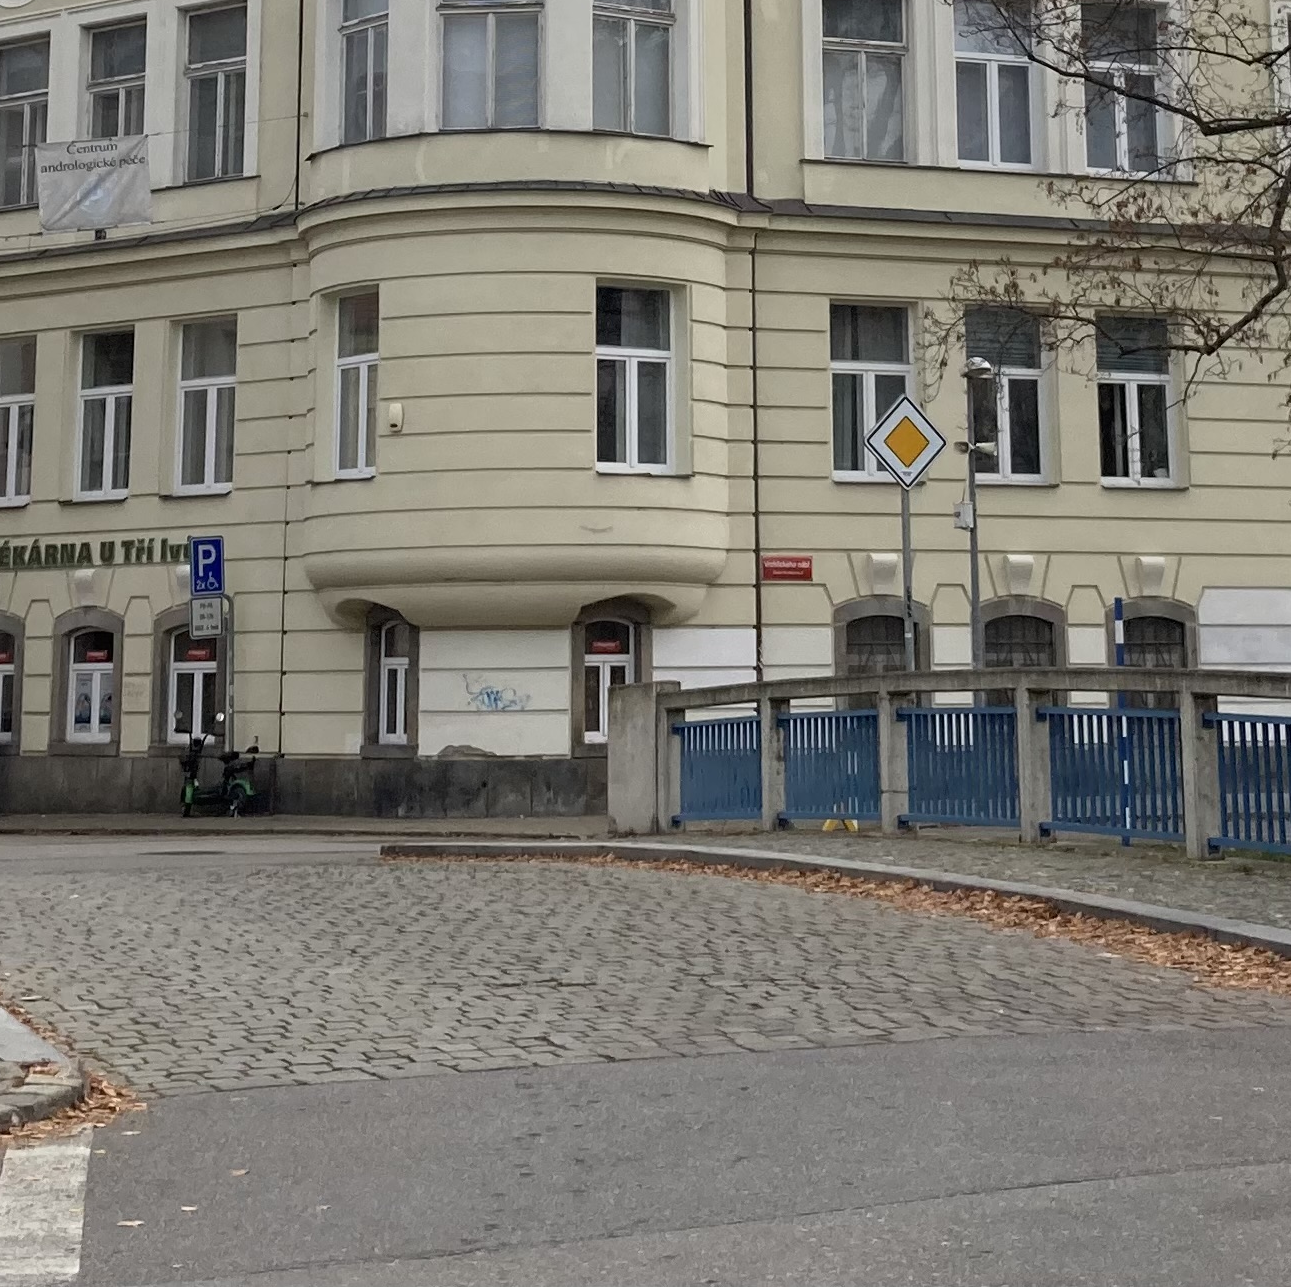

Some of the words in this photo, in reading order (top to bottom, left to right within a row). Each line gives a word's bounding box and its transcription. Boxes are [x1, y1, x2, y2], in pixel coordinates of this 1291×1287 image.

[66, 143, 118, 155] Centrum
[40, 158, 117, 173] andrologické
[118, 154, 146, 168] péče
[99, 540, 116, 564] U
[120, 538, 155, 563] Tří
[197, 544, 217, 577] P
